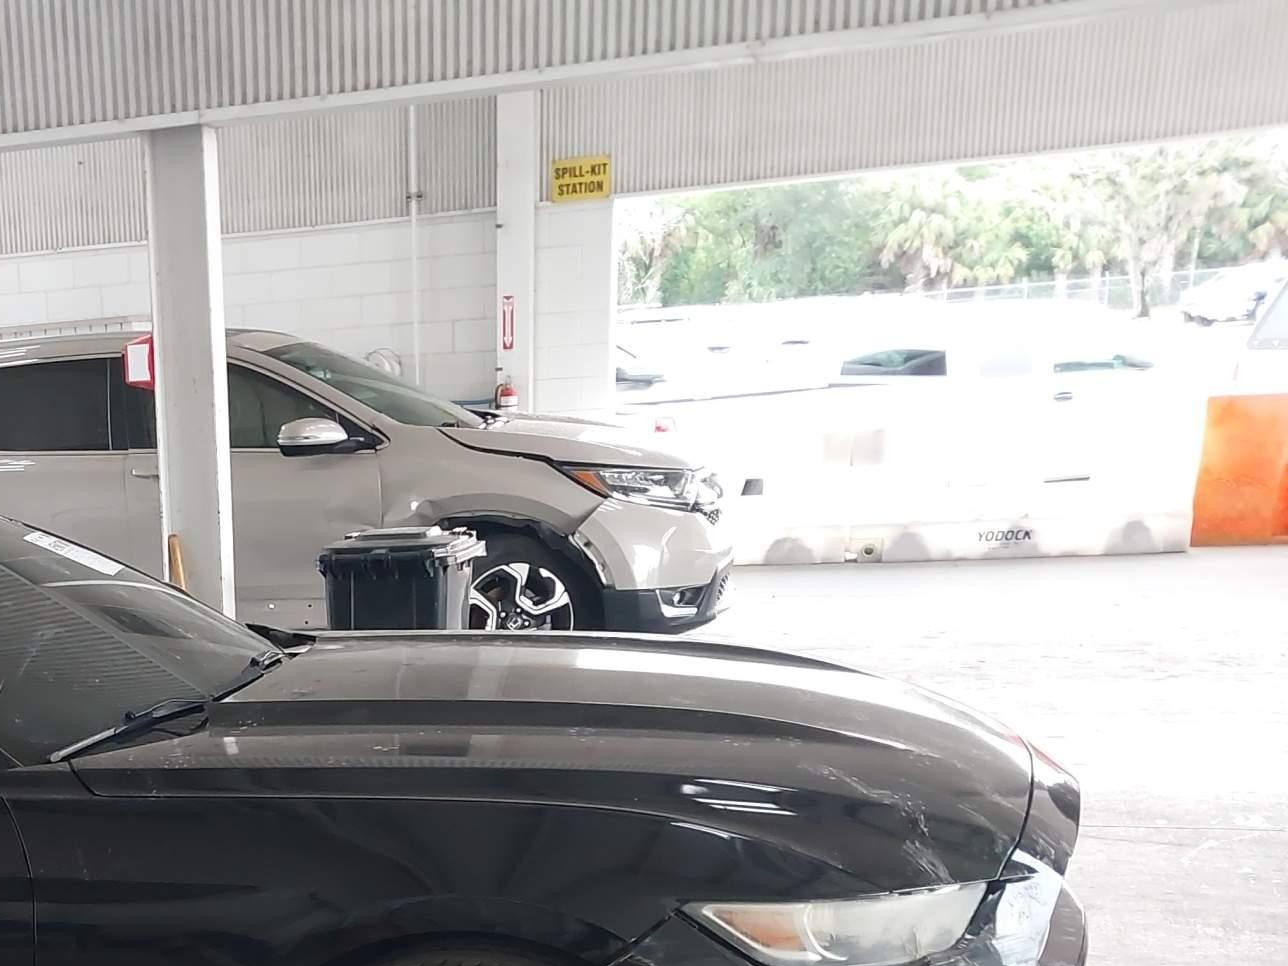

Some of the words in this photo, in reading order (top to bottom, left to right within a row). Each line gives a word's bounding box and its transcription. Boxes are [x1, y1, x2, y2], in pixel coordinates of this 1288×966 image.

[554, 163, 608, 180] SPILL-KIT
[558, 180, 604, 196] STATION
[978, 529, 1032, 542] YODOCK
